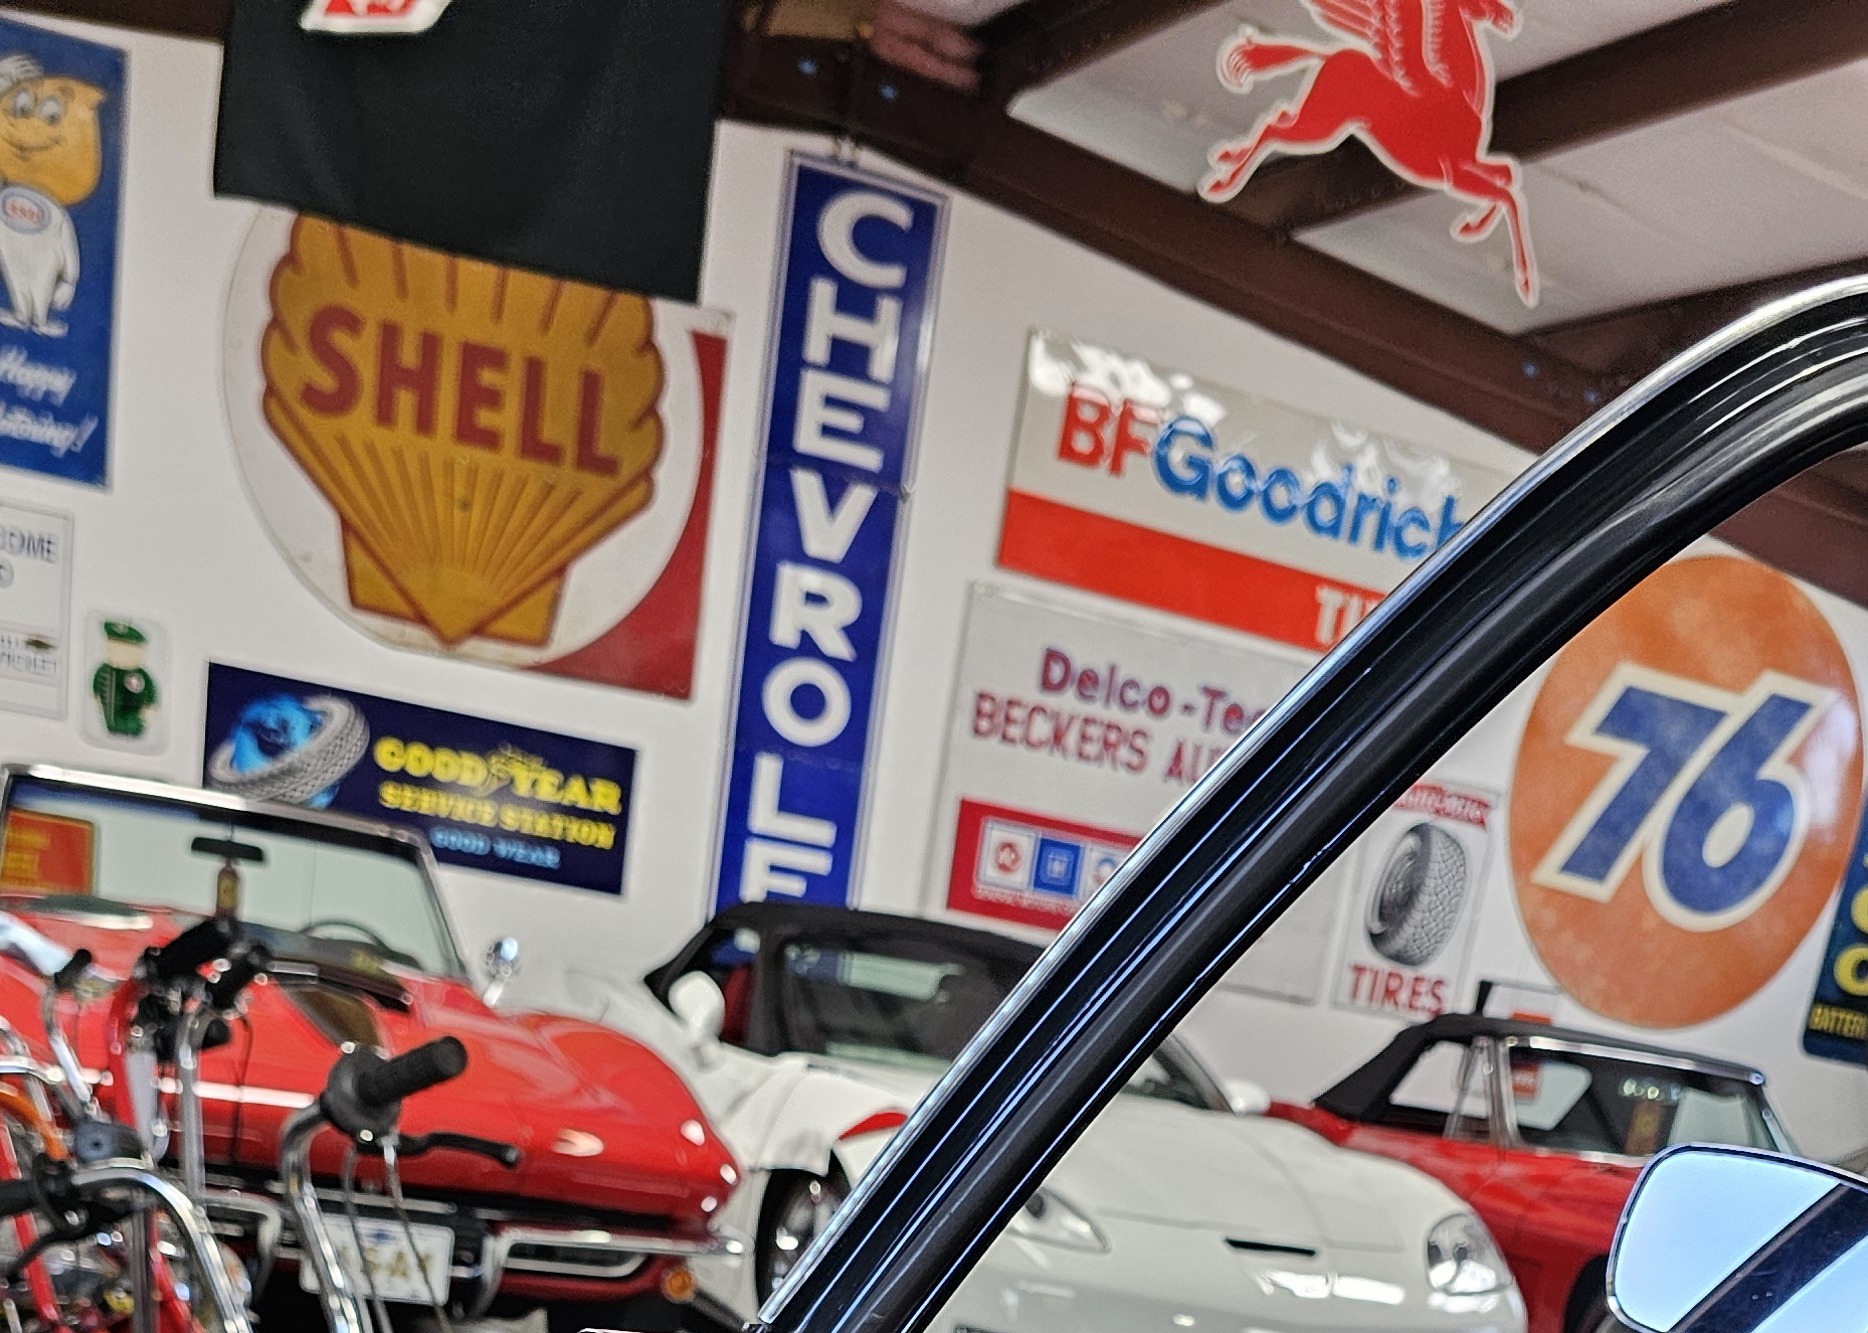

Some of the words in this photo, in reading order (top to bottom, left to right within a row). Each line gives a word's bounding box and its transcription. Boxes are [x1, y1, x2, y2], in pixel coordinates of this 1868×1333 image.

[300, 303, 620, 478] SHELL
[1314, 584, 1382, 645] TI
[973, 690, 1149, 774] BECKERS
[379, 781, 498, 828] SERVICE
[499, 804, 617, 850] STATION
[1545, 674, 1827, 924] 76
[1350, 963, 1447, 1019] TIRES
